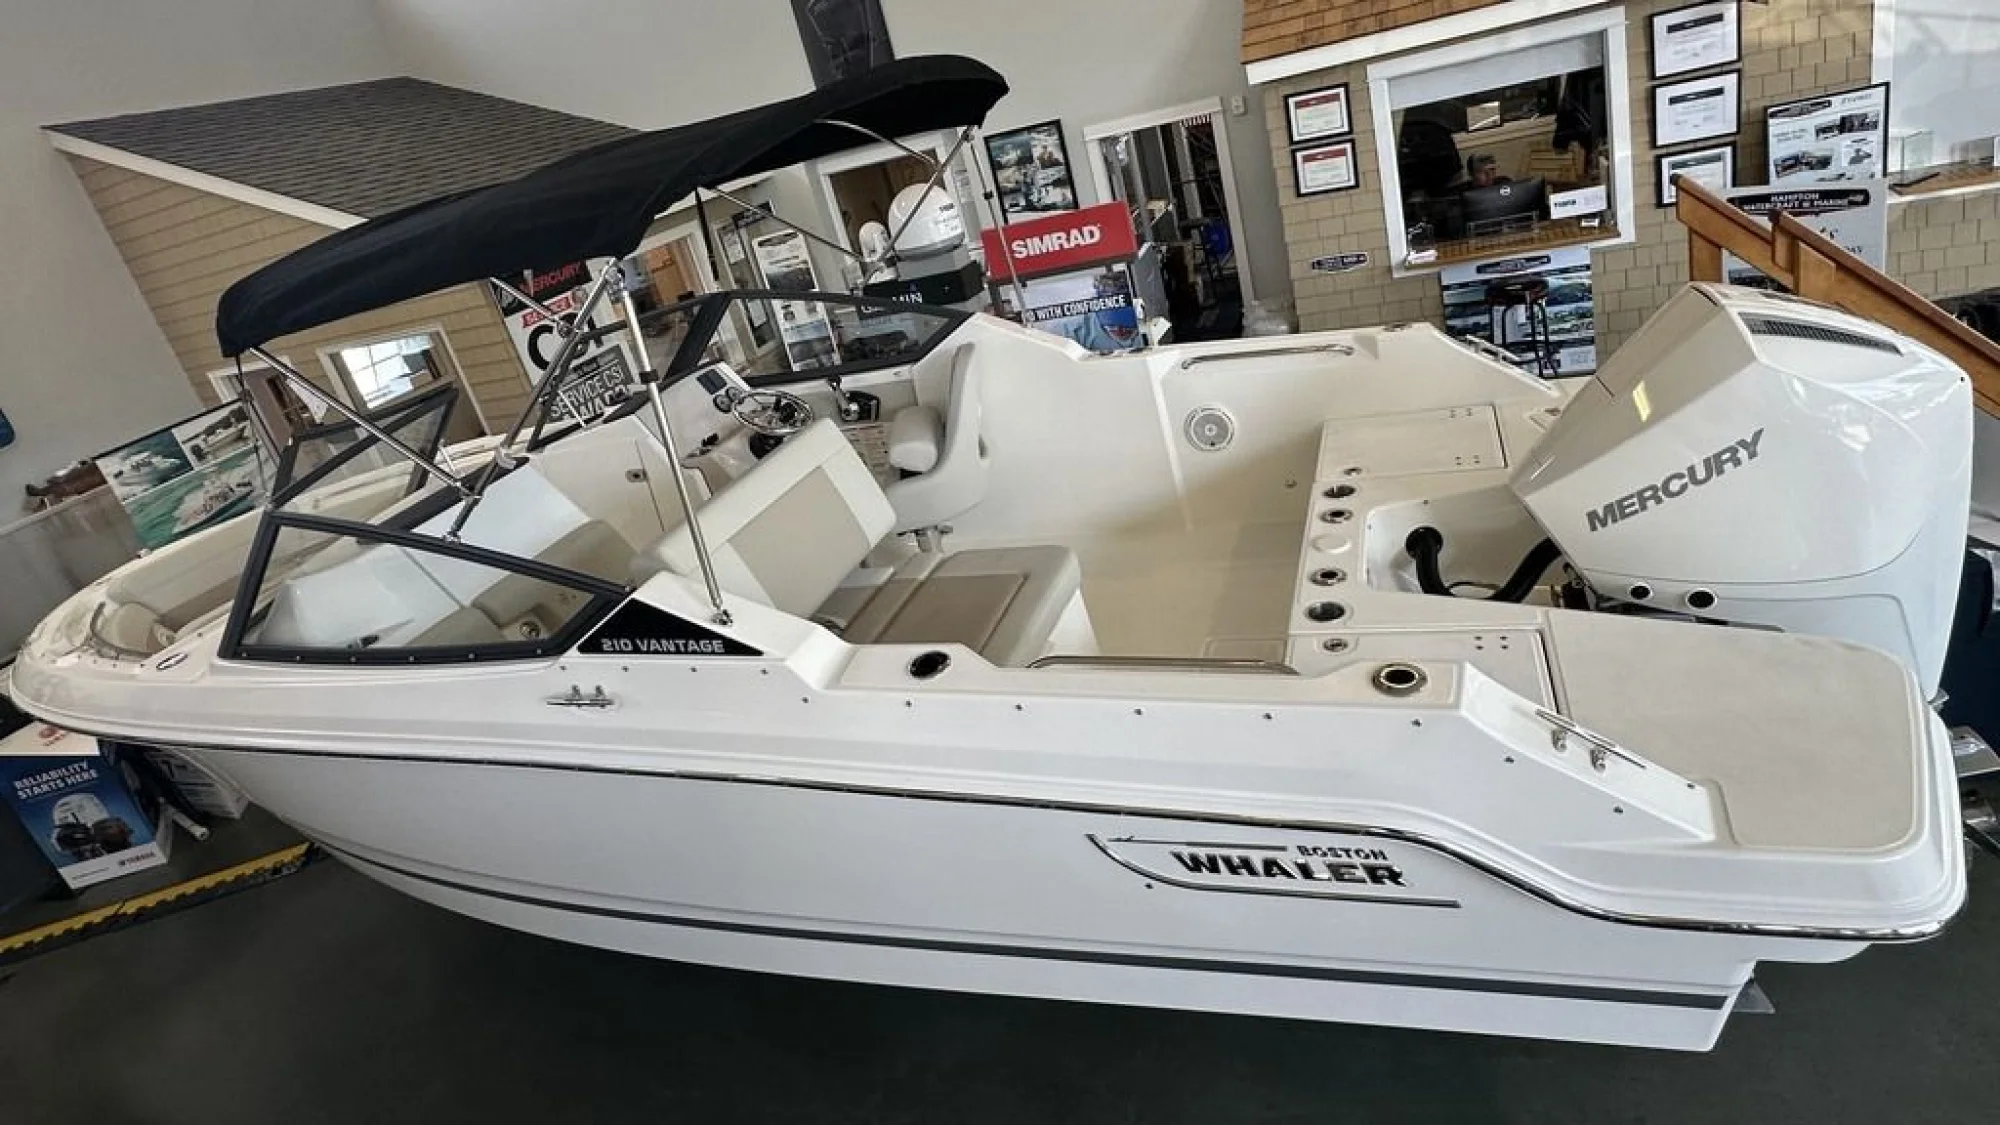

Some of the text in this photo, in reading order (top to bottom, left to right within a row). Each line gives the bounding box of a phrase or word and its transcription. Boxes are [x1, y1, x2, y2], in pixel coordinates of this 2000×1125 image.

[1011, 225, 1100, 259] SIMRAD
[1036, 303, 1062, 320] WITH
[1064, 294, 1126, 316] CONFIDENCE
[550, 379, 603, 418] SERVICE
[1586, 427, 1765, 531] MERCURY
[601, 637, 726, 653] 210 VANTAGE
[13, 760, 89, 790] RELIABILITY
[17, 768, 99, 799] STARTS HERE
[1296, 844, 1389, 860] BOSTON
[1170, 850, 1408, 887] WHALER
